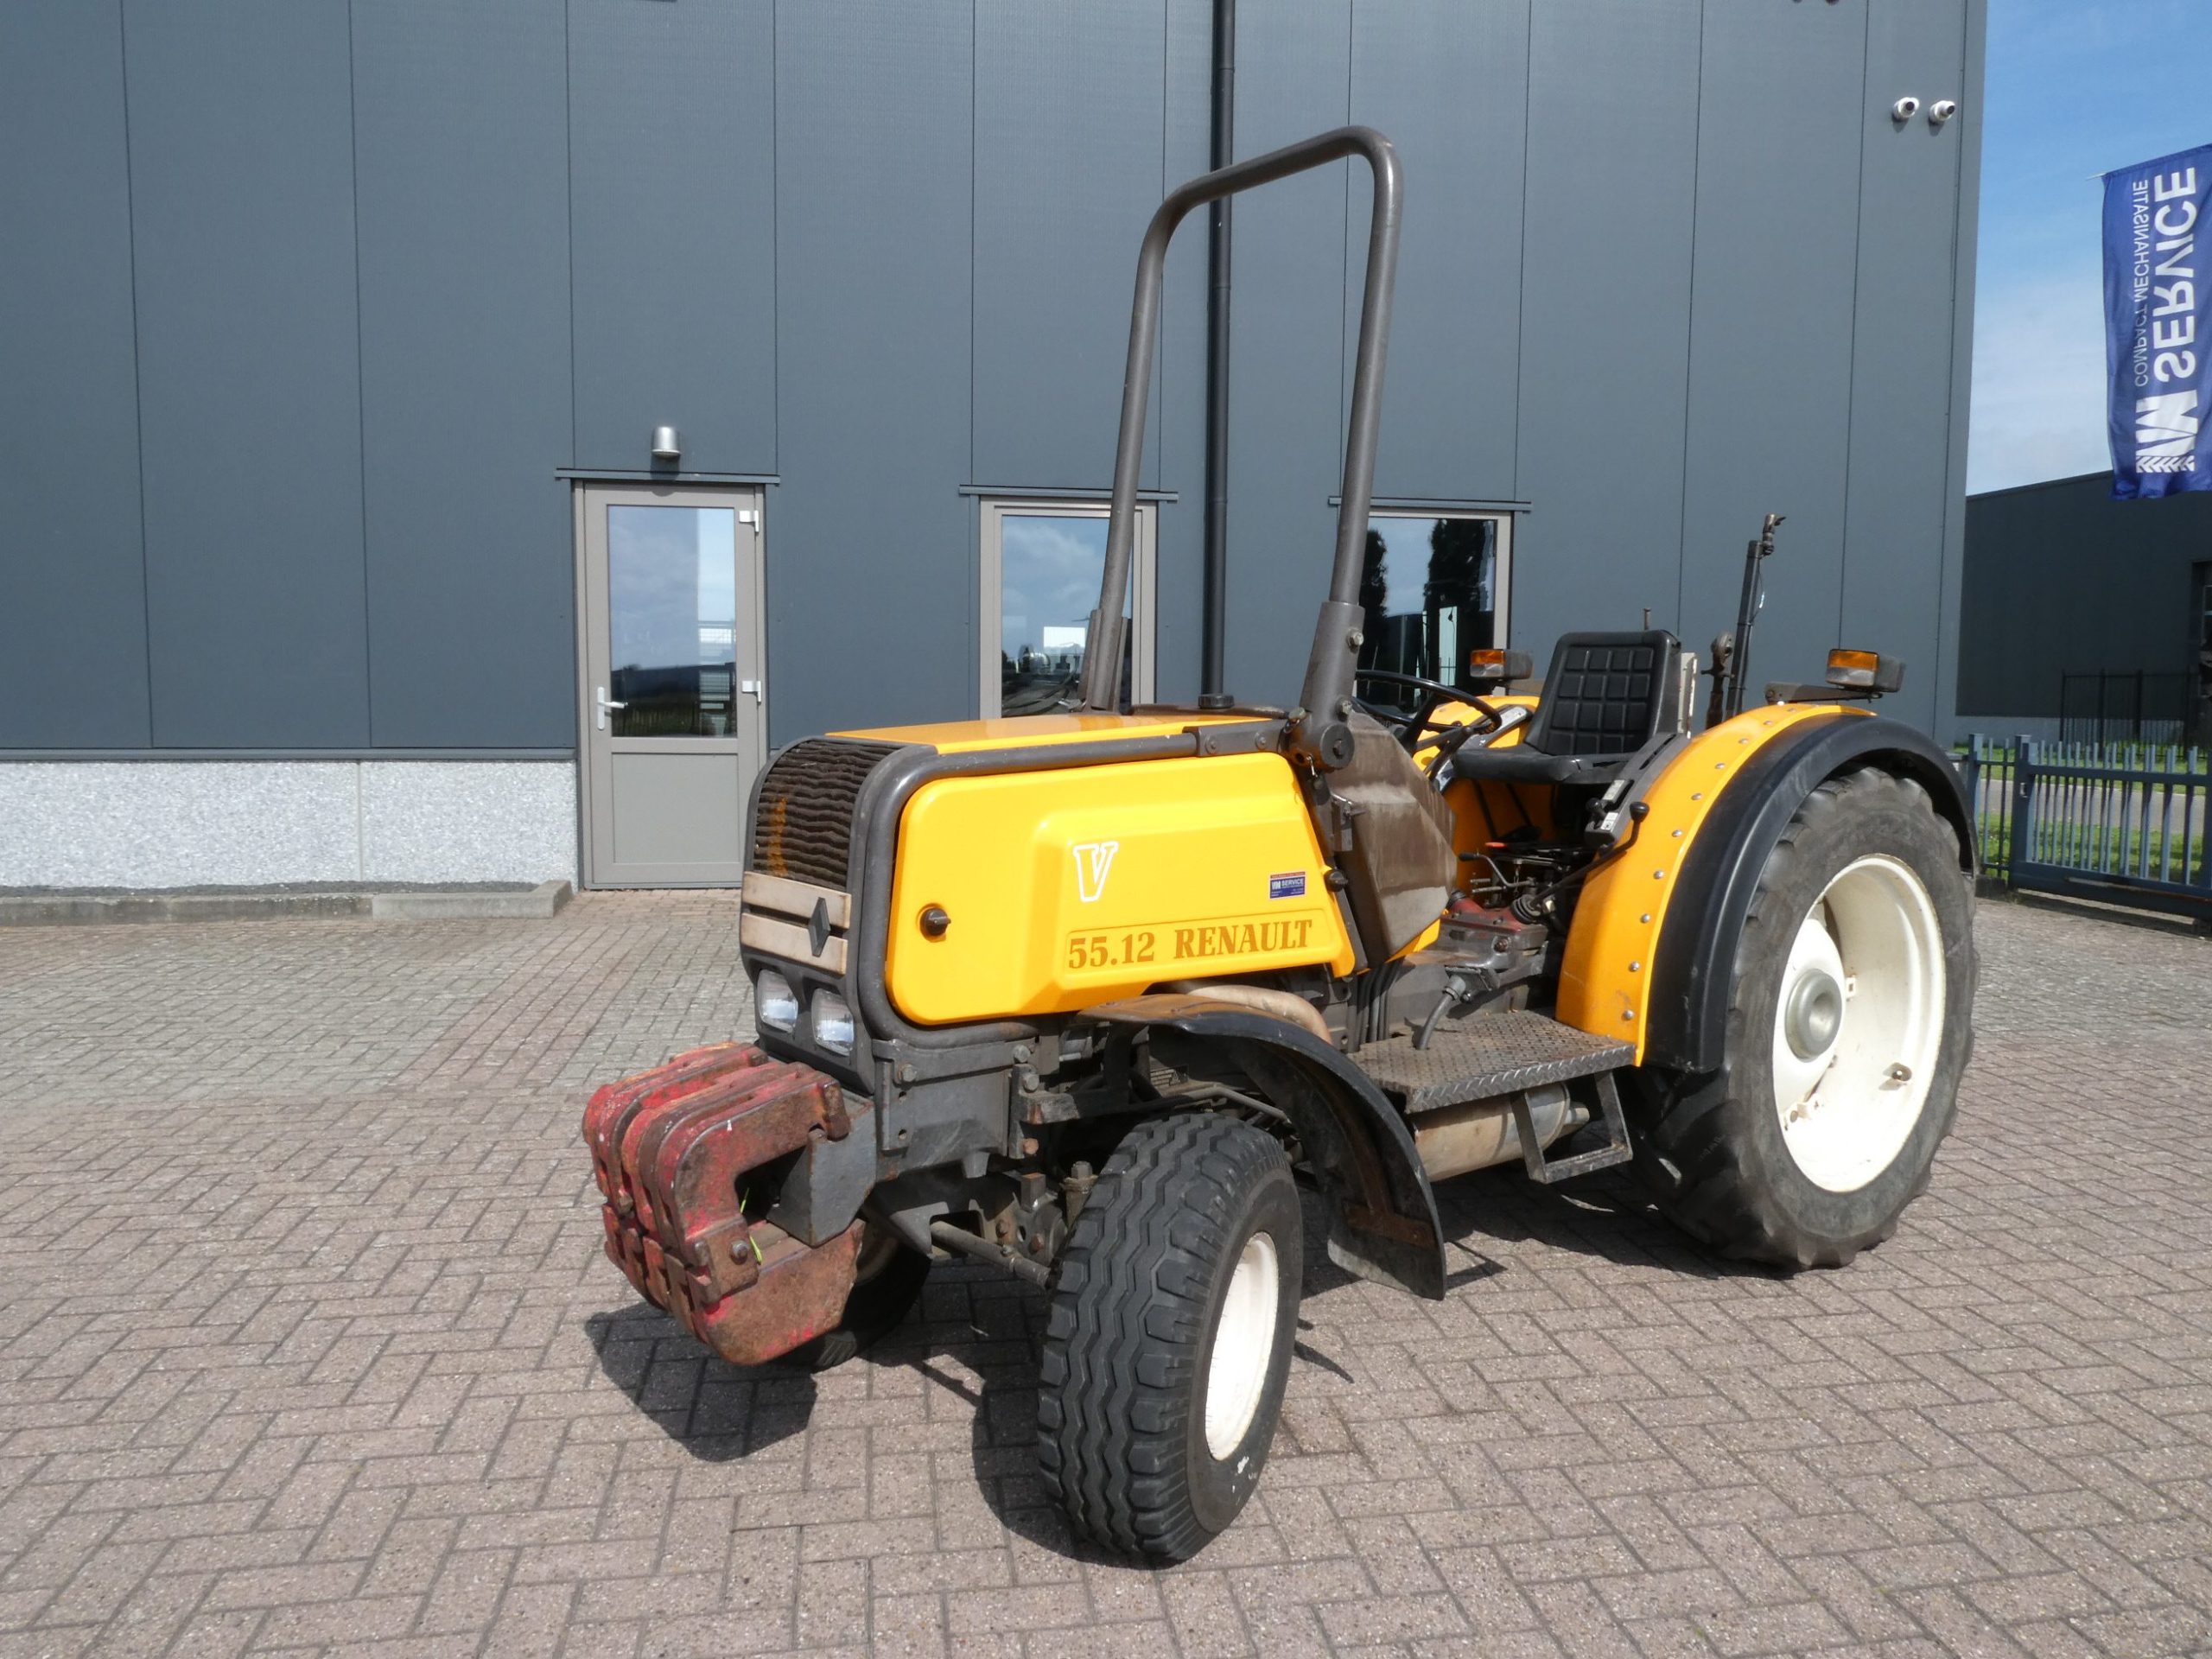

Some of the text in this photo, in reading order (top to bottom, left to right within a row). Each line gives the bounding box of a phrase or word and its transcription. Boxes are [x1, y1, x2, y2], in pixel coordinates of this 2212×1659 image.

[1072, 841, 1119, 903] V
[1068, 918, 1313, 969] 55.12 RENAULT
